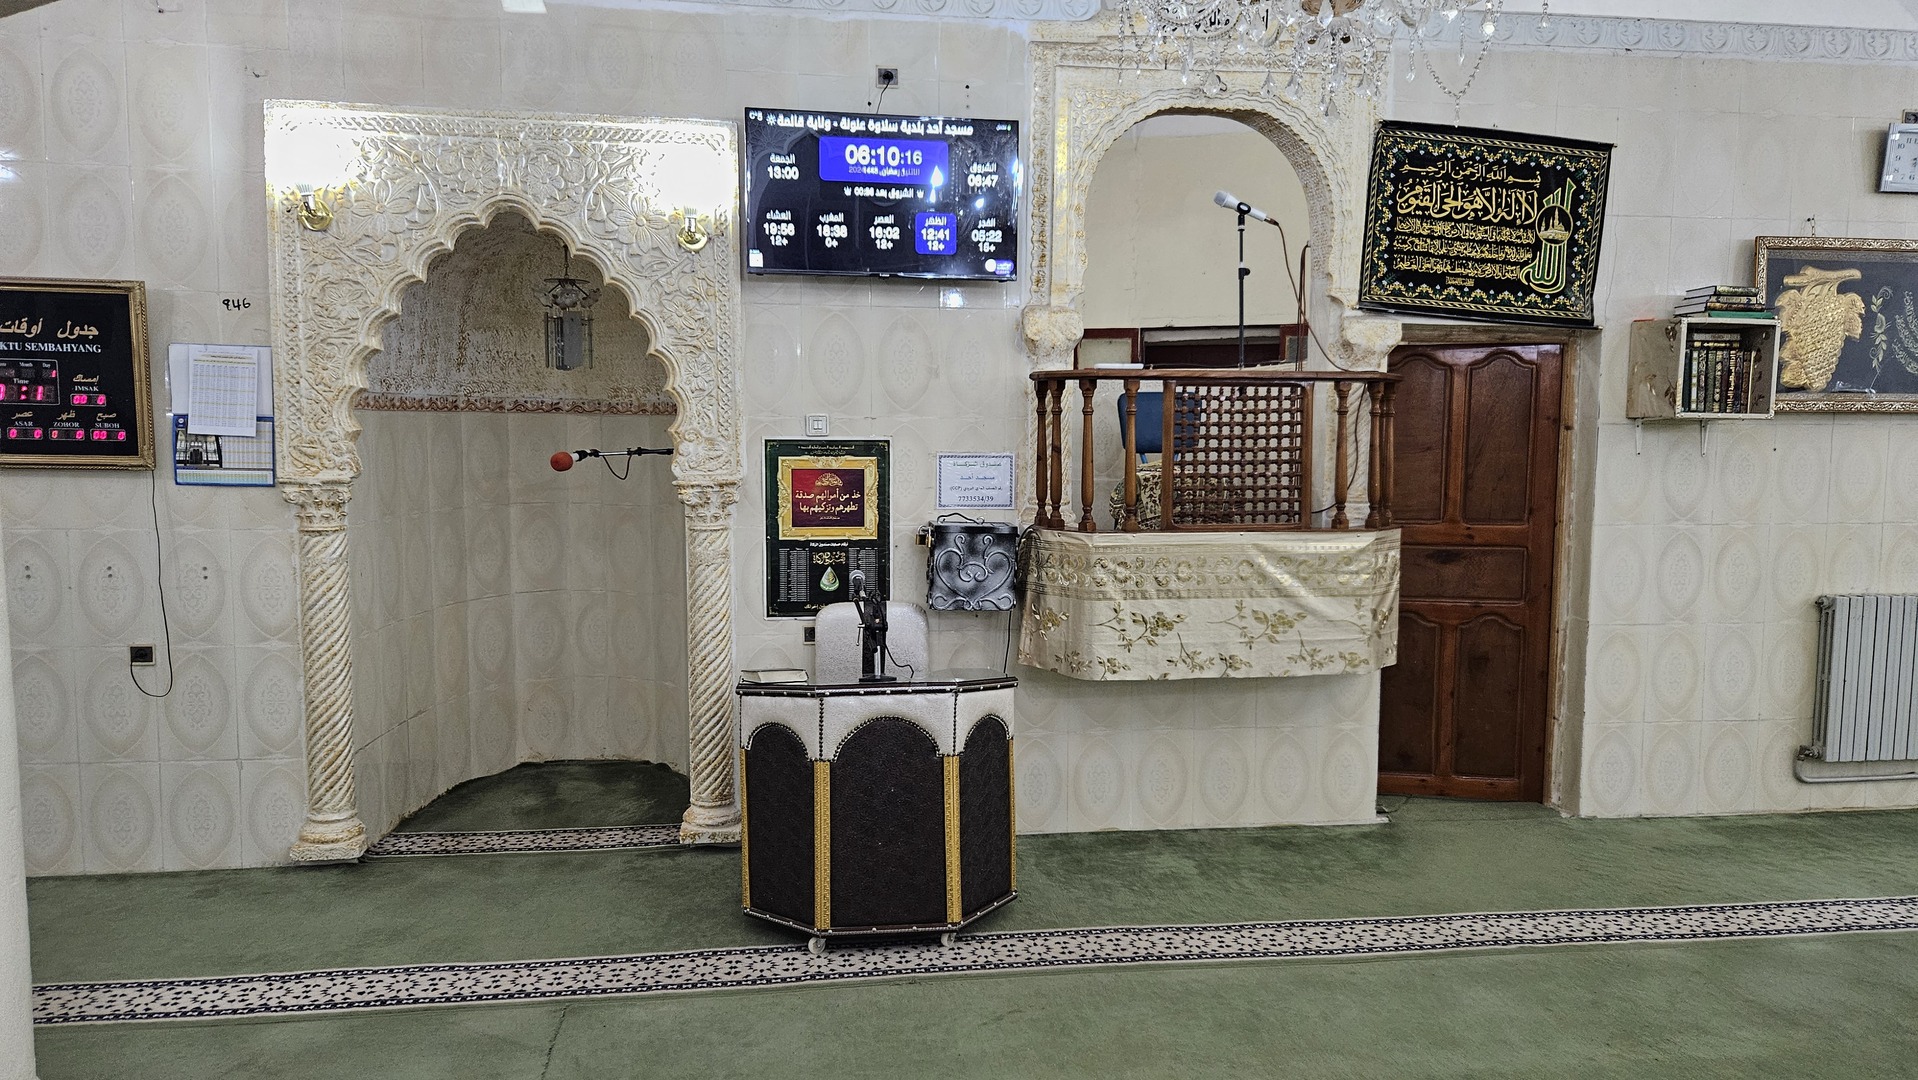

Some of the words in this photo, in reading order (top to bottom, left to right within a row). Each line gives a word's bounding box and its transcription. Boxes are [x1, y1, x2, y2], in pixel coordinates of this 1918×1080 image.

[777, 113, 805, 128] قالمة
[806, 115, 831, 131] ولاية
[868, 118, 899, 134] سلاوة
[900, 119, 925, 136] بلدية
[944, 124, 974, 137] مسجد
[767, 165, 799, 180] 13:00
[967, 174, 999, 188] 06:47
[766, 209, 791, 221] العشاء
[819, 212, 844, 223] المغرب
[873, 214, 894, 225] العصر
[925, 216, 946, 228] الظهر
[977, 218, 996, 229] الفجر
[921, 228, 950, 241] 12:41
[971, 229, 1002, 243] 05:22
[222, 298, 251, 311] 946
[57, 320, 99, 339] جدول
[25, 342, 101, 353] SEMBAHYANG
[11, 411, 33, 419] عصر
[56, 409, 76, 420] ظهر
[96, 412, 117, 421] صبح
[795, 490, 814, 499] صدقة
[816, 488, 839, 503] أموالهم
[852, 490, 861, 499] خذ
[800, 502, 809, 513] بها
[810, 501, 834, 516] وتزكيهم
[835, 501, 859, 515] تطهرهم
